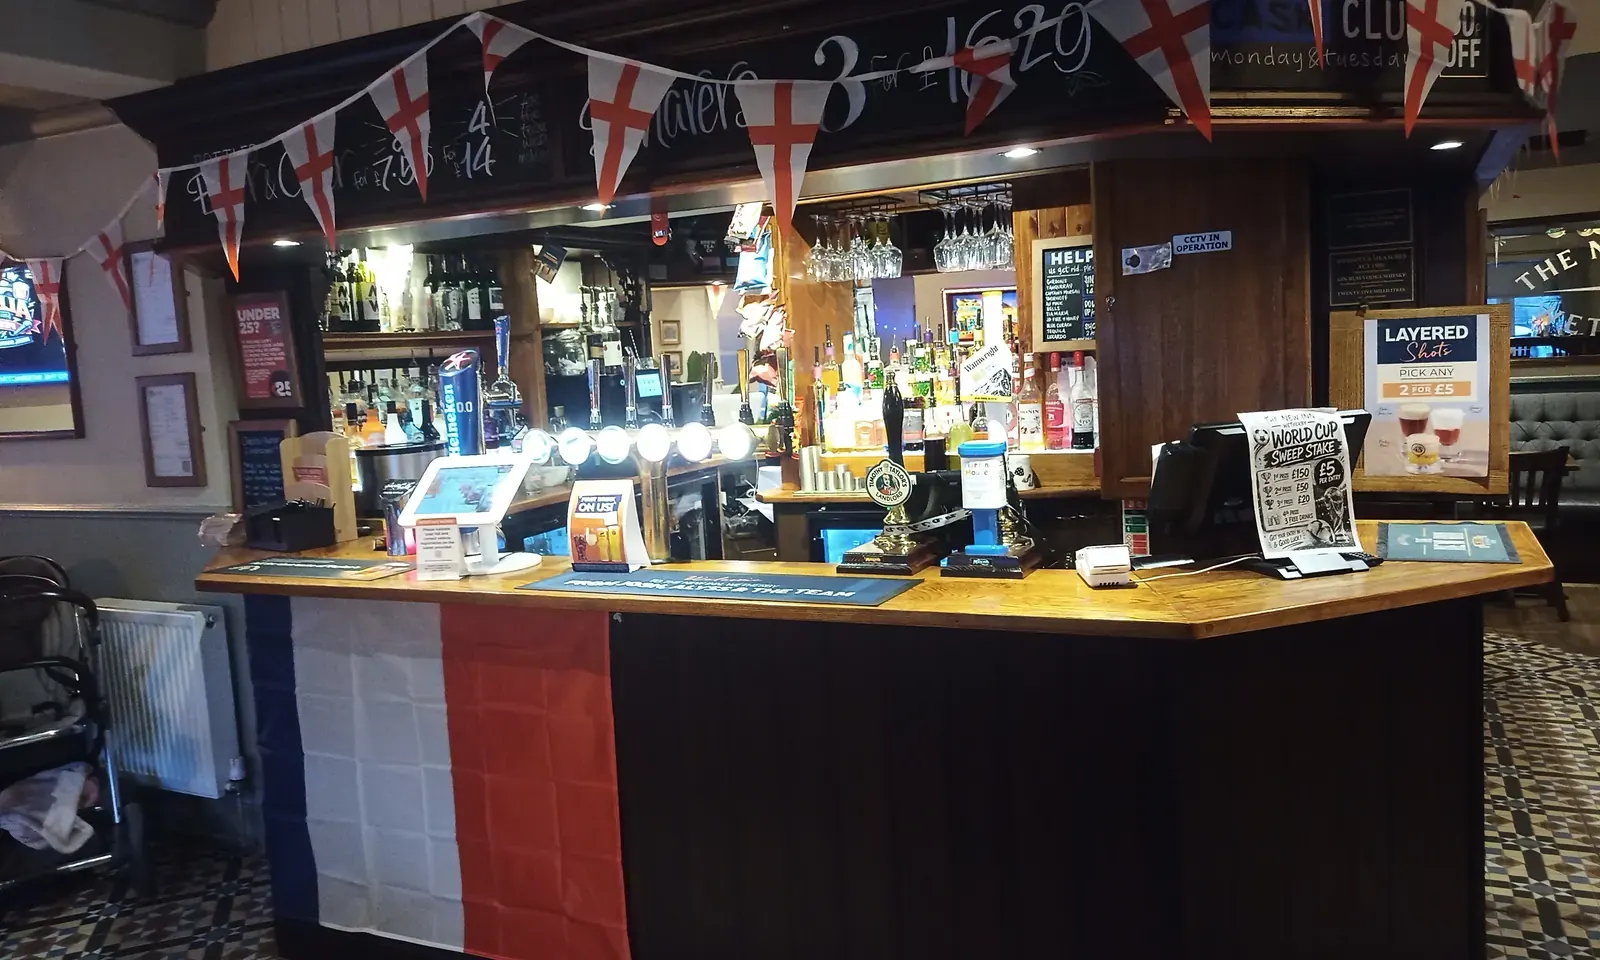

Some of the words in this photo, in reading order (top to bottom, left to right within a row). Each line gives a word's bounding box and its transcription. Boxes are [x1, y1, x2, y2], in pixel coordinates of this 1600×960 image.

[1341, 0, 1406, 40] CLU
[813, 35, 867, 133] 3
[468, 100, 491, 136] 4
[1183, 235, 1207, 244] CCTV
[1209, 233, 1220, 241] IN
[1176, 241, 1228, 253] OPERATION
[1051, 249, 1094, 265] HELP
[1514, 249, 1578, 291] THE
[237, 307, 281, 321] UNDER
[239, 321, 260, 335] 25?
[1385, 325, 1469, 343] LAYERED
[964, 345, 999, 373] Wainwright
[1400, 341, 1452, 362] Shots
[1399, 369, 1427, 378] PICK
[1430, 368, 1454, 377] ANY
[1399, 384, 1409, 396] 2
[1411, 386, 1432, 394] FOR
[1434, 384, 1454, 395] £5
[456, 401, 473, 413] 0.0
[444, 384, 460, 456] Heineken
[1271, 427, 1313, 449] WORLD
[1315, 421, 1338, 441] CUP
[1271, 447, 1304, 465] SWEEP
[1305, 441, 1335, 458] STAKE
[1291, 467, 1310, 480] £150
[1319, 460, 1336, 477] £5
[869, 466, 883, 488] TIMOTHY
[889, 466, 908, 488] TAYLOR'S
[1296, 482, 1309, 492] £50
[875, 490, 903, 502] LANDLORD
[1298, 494, 1310, 504] £20
[578, 502, 595, 512] ON
[751, 587, 794, 595] THE
[794, 588, 857, 597] TEAM
